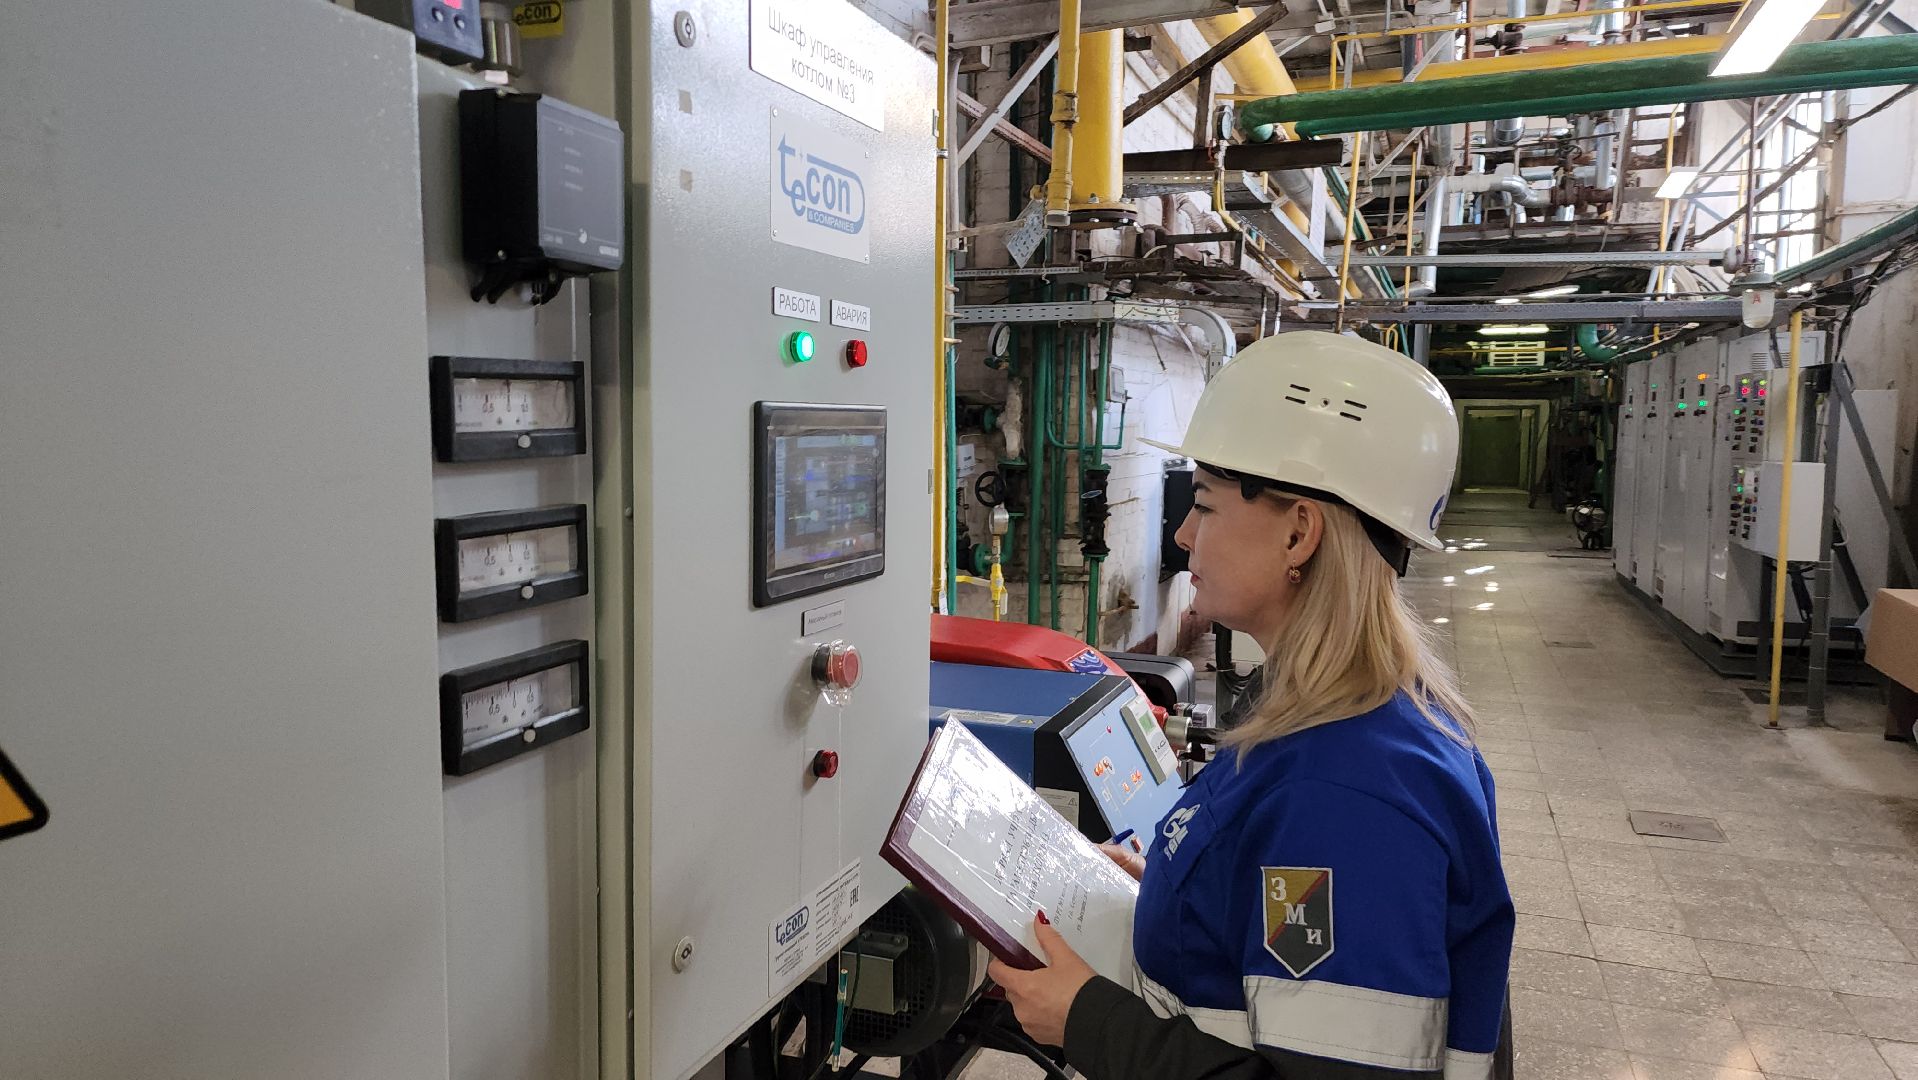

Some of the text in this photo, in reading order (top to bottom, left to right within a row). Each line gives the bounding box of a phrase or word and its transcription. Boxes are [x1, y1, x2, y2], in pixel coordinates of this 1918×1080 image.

[768, 6, 874, 85] Шкаф управления
[791, 58, 855, 104] котлом №3
[814, 212, 855, 233] COMPANIES
[779, 293, 817, 316] РАБОТА
[836, 305, 868, 326] АВАРИЯ
